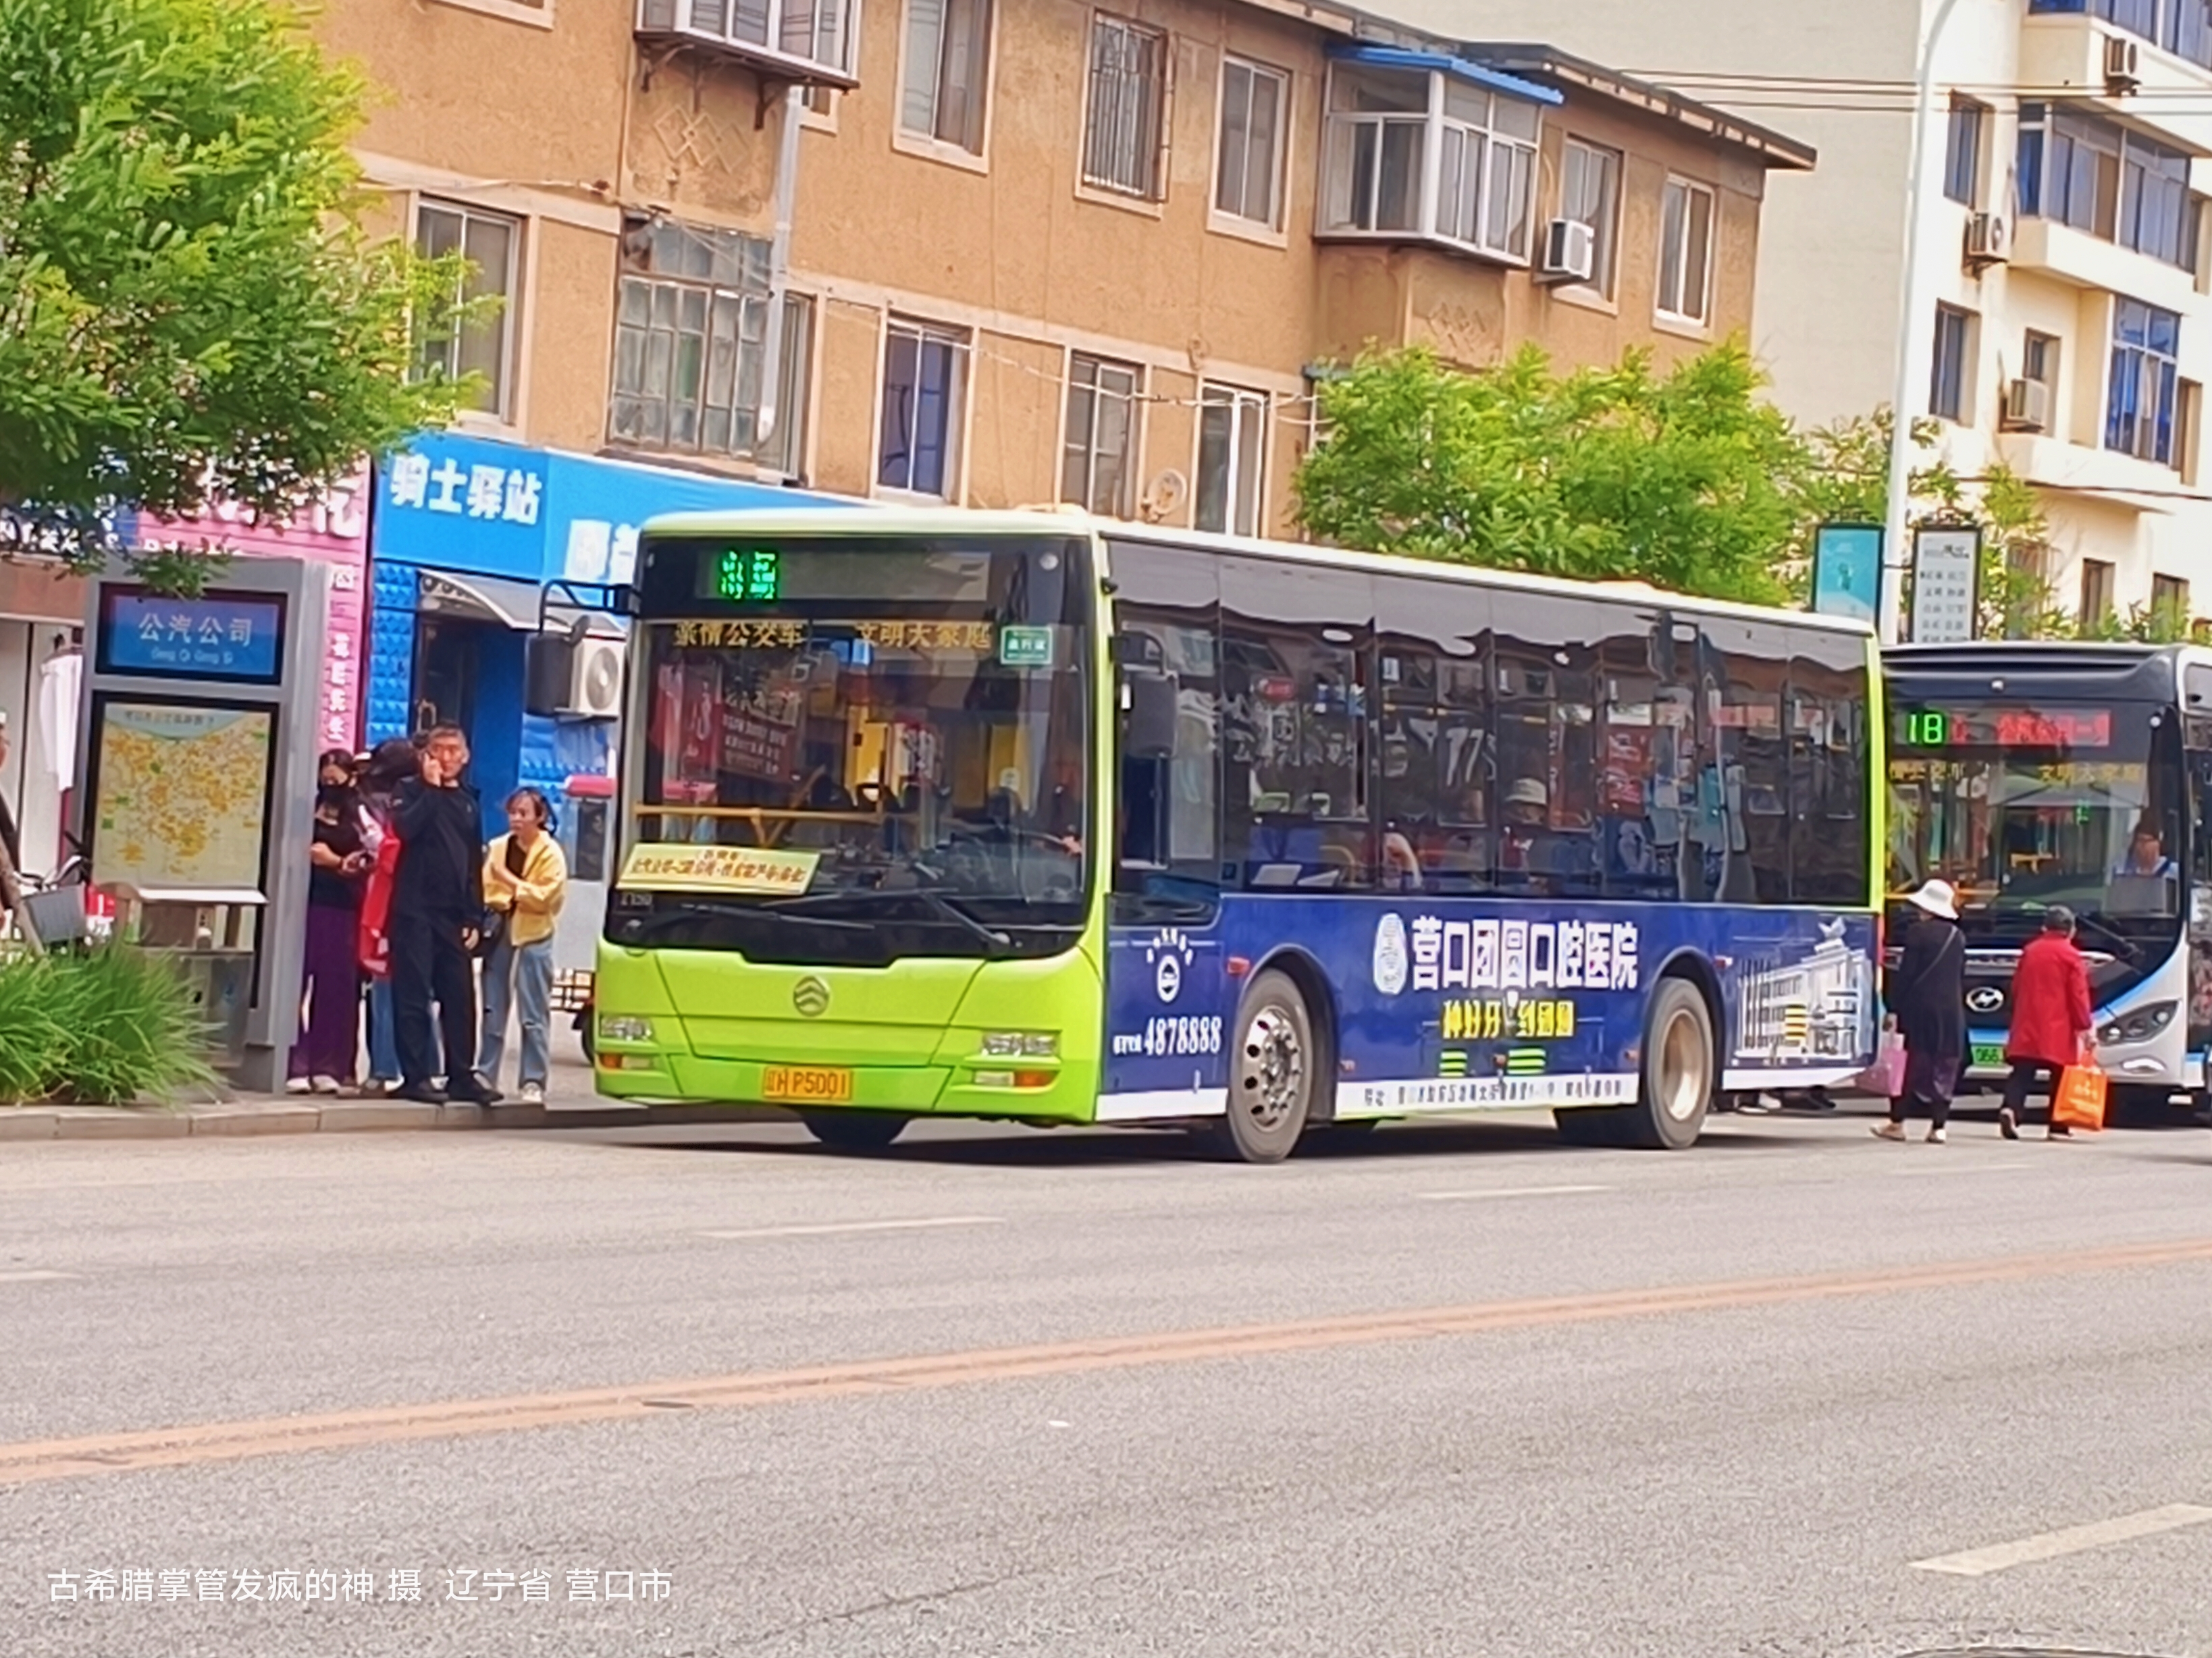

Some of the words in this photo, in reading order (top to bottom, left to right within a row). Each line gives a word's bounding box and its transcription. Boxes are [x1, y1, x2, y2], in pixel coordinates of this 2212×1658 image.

[390, 453, 542, 525] 骑士驿站
[138, 613, 253, 647] 公汽公司
[1909, 713, 1943, 743] 18
[1412, 915, 1639, 990] 营口团圆口腔医院
[1144, 1016, 1223, 1056] 4878888
